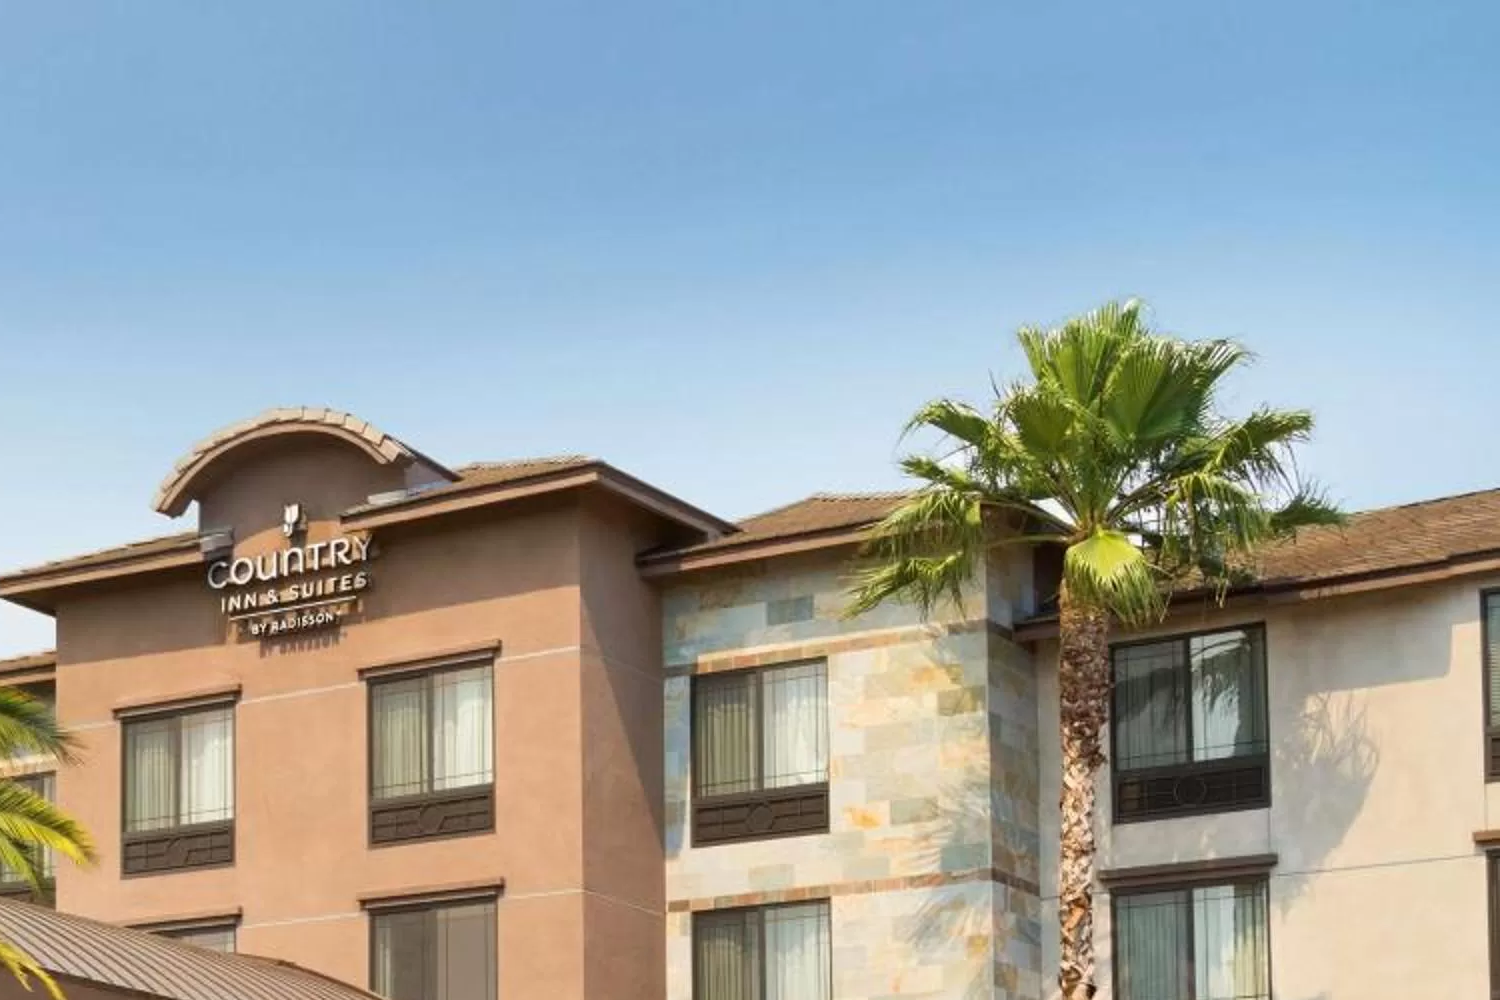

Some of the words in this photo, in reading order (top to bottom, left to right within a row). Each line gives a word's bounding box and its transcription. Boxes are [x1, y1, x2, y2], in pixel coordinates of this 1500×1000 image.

[207, 534, 373, 589] COUNTRY
[221, 593, 257, 614] INN
[267, 588, 279, 605] &
[288, 572, 368, 599] SUITES
[251, 622, 266, 635] BY
[270, 611, 334, 634] RADISSON
